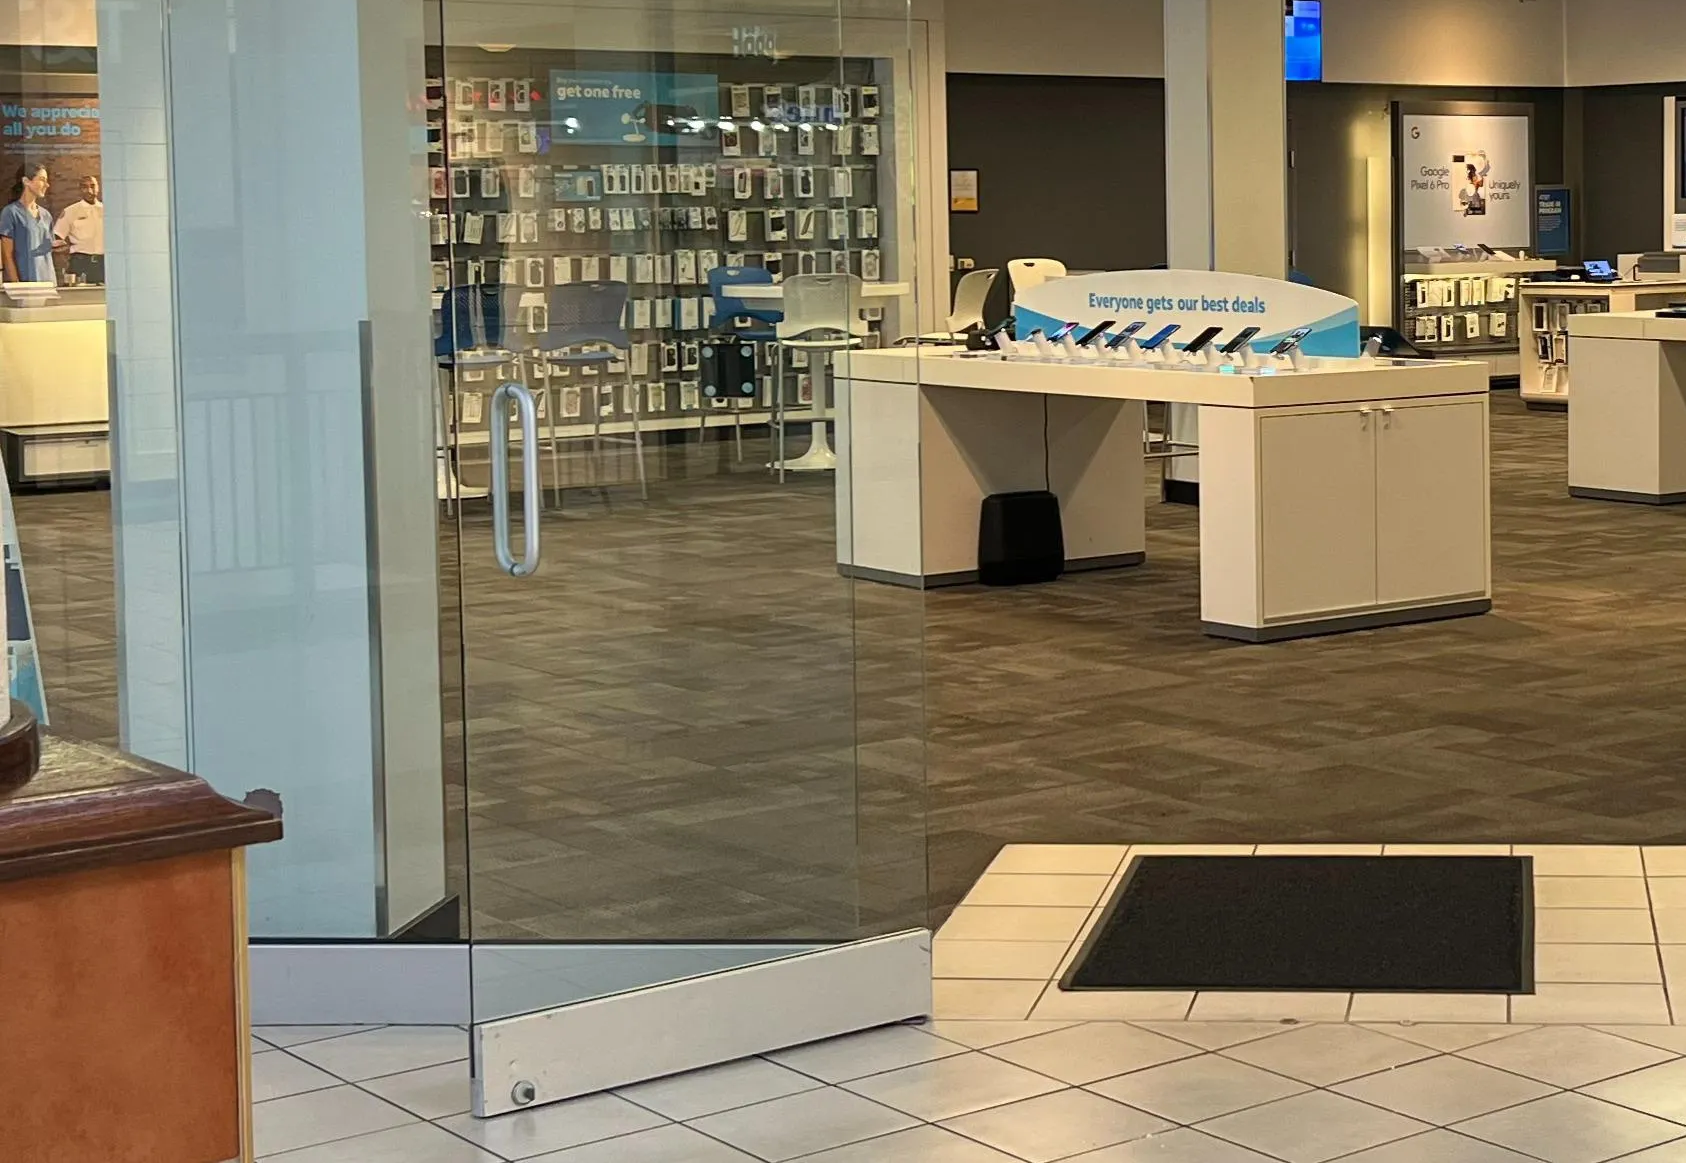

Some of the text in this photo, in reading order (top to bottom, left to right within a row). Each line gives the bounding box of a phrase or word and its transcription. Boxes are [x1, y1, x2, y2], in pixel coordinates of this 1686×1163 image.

[556, 84, 641, 100] get one free
[2, 105, 26, 118] We
[4, 122, 81, 139] all you do
[1420, 166, 1449, 179] Google
[1411, 180, 1428, 190] Pixel
[1436, 180, 1450, 190] Pro
[1088, 292, 1265, 314] Everyone gets our best deals
